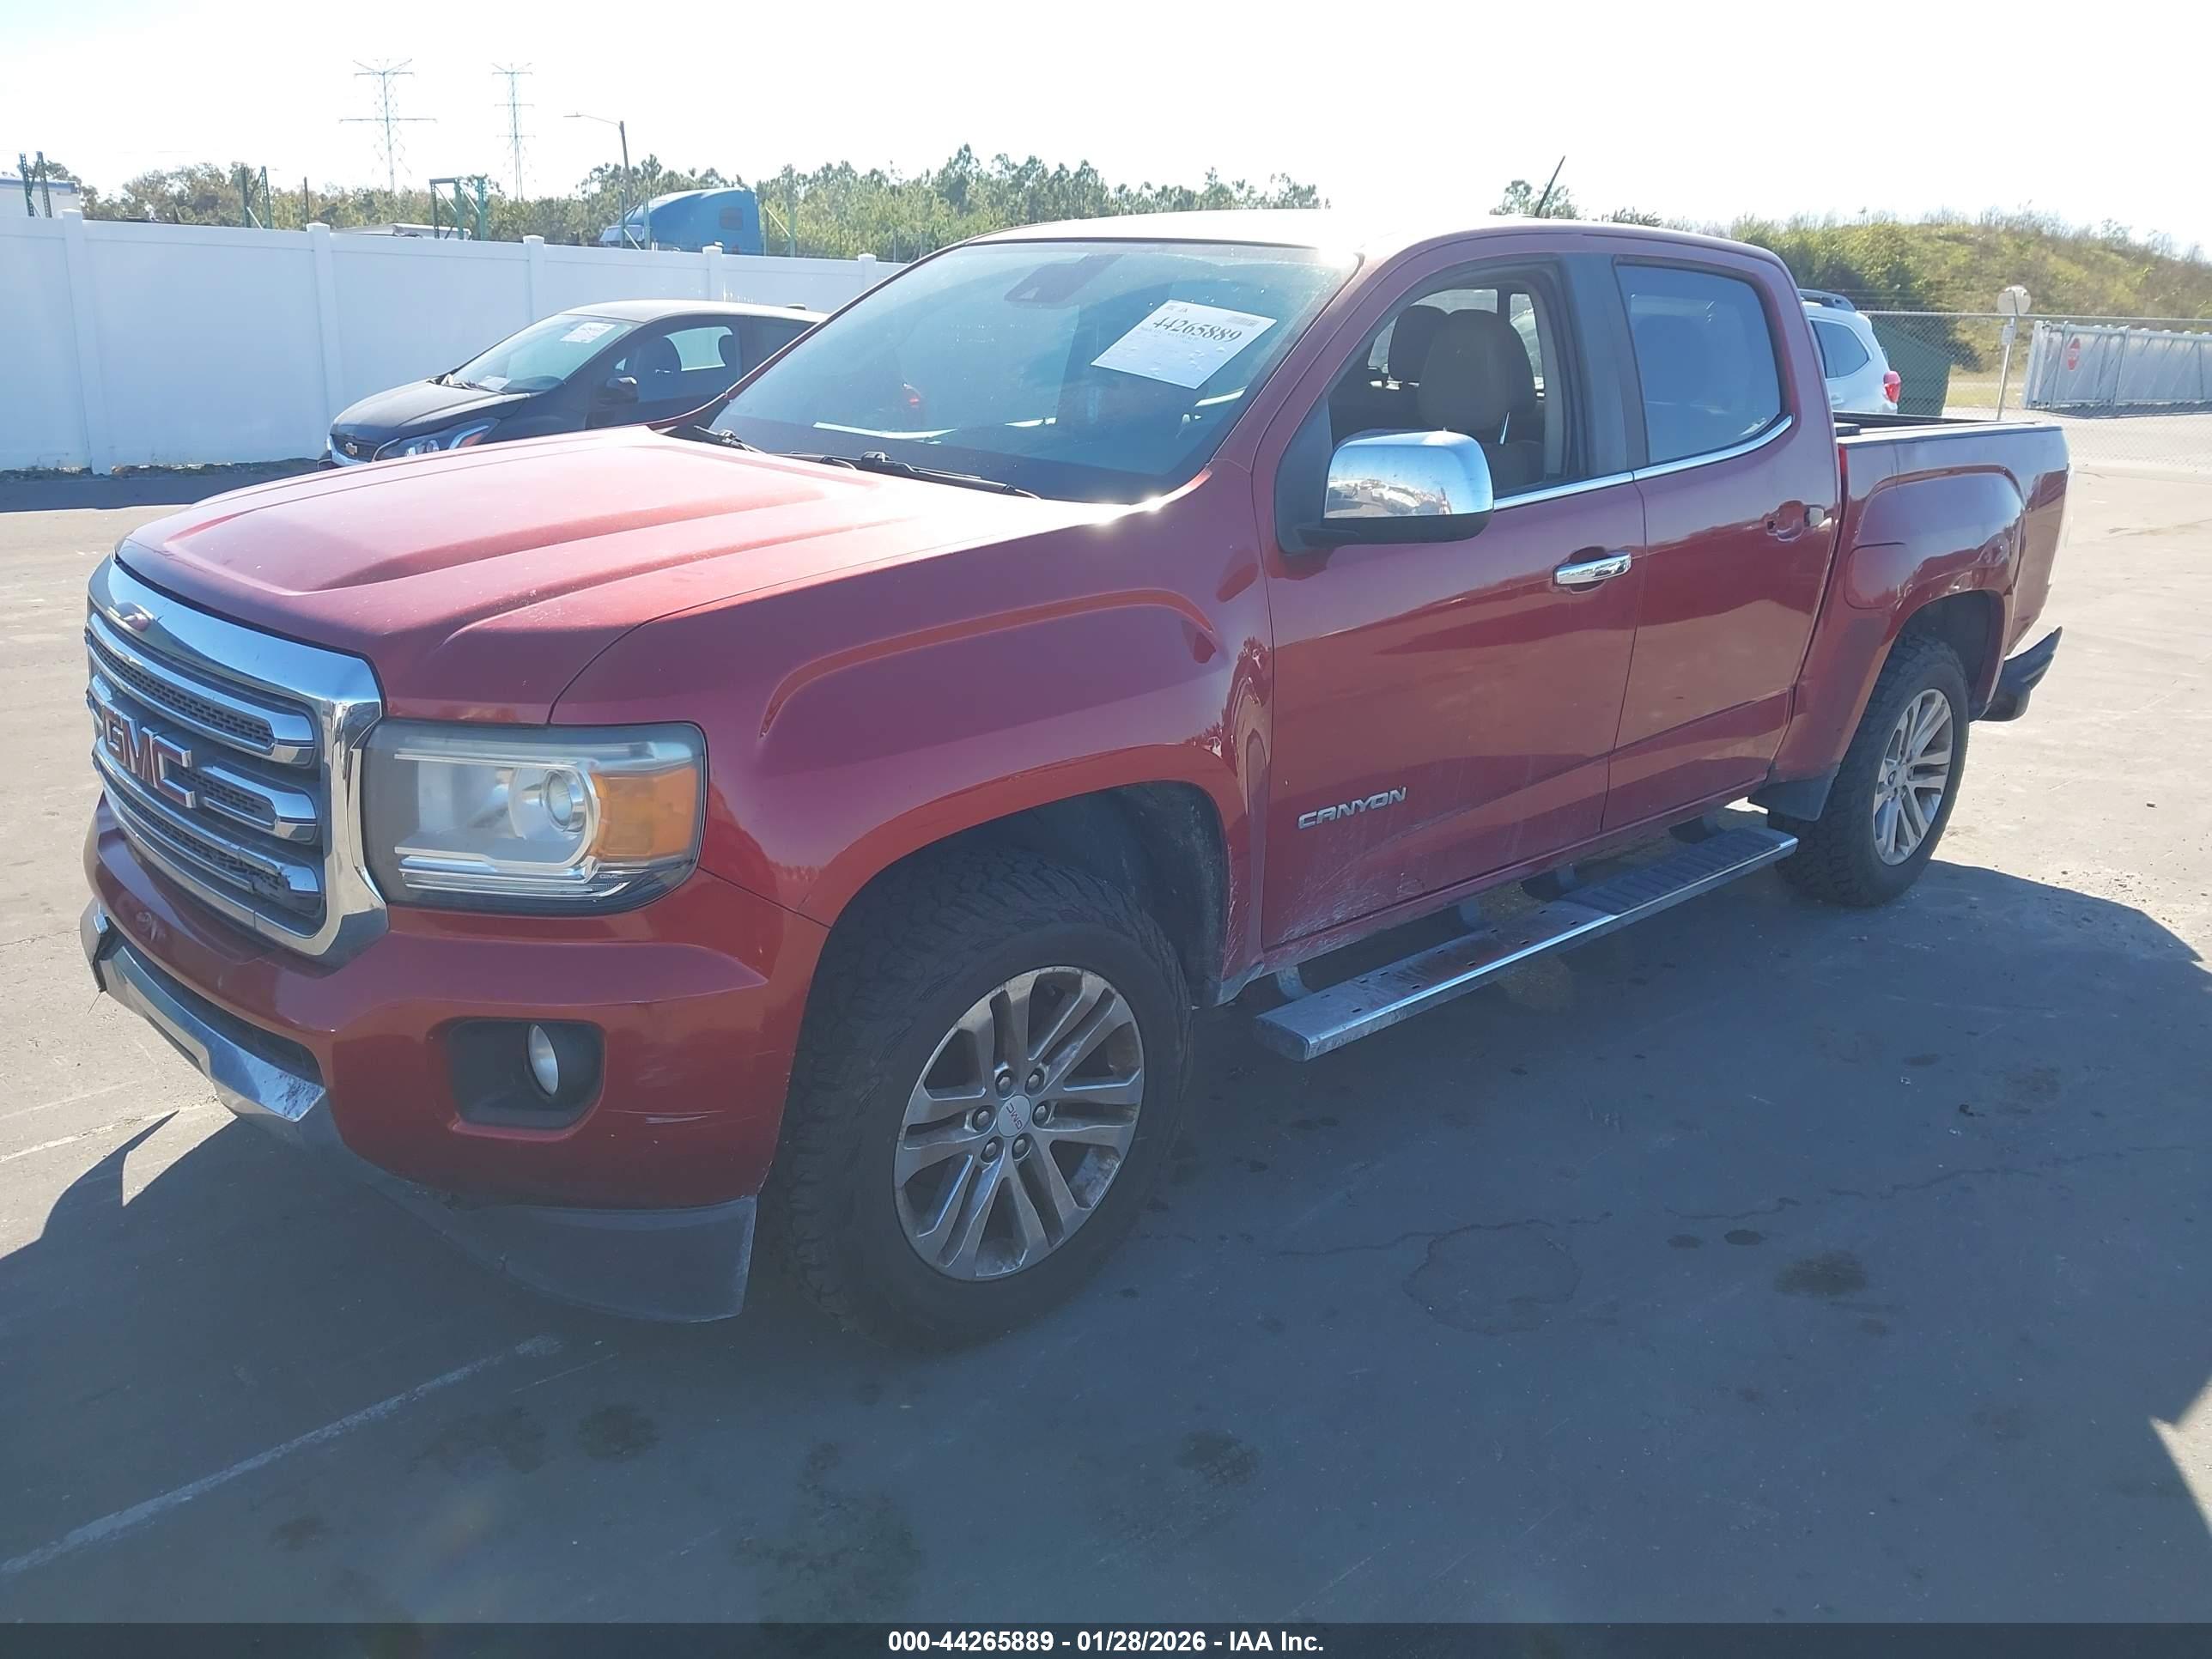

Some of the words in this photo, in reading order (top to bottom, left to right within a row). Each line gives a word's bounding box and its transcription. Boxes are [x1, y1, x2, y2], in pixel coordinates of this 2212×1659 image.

[1153, 317, 1243, 343] 44265889
[102, 705, 196, 808] GMC
[1297, 787, 1407, 830] CANYON
[1006, 1102, 1023, 1130] GMC
